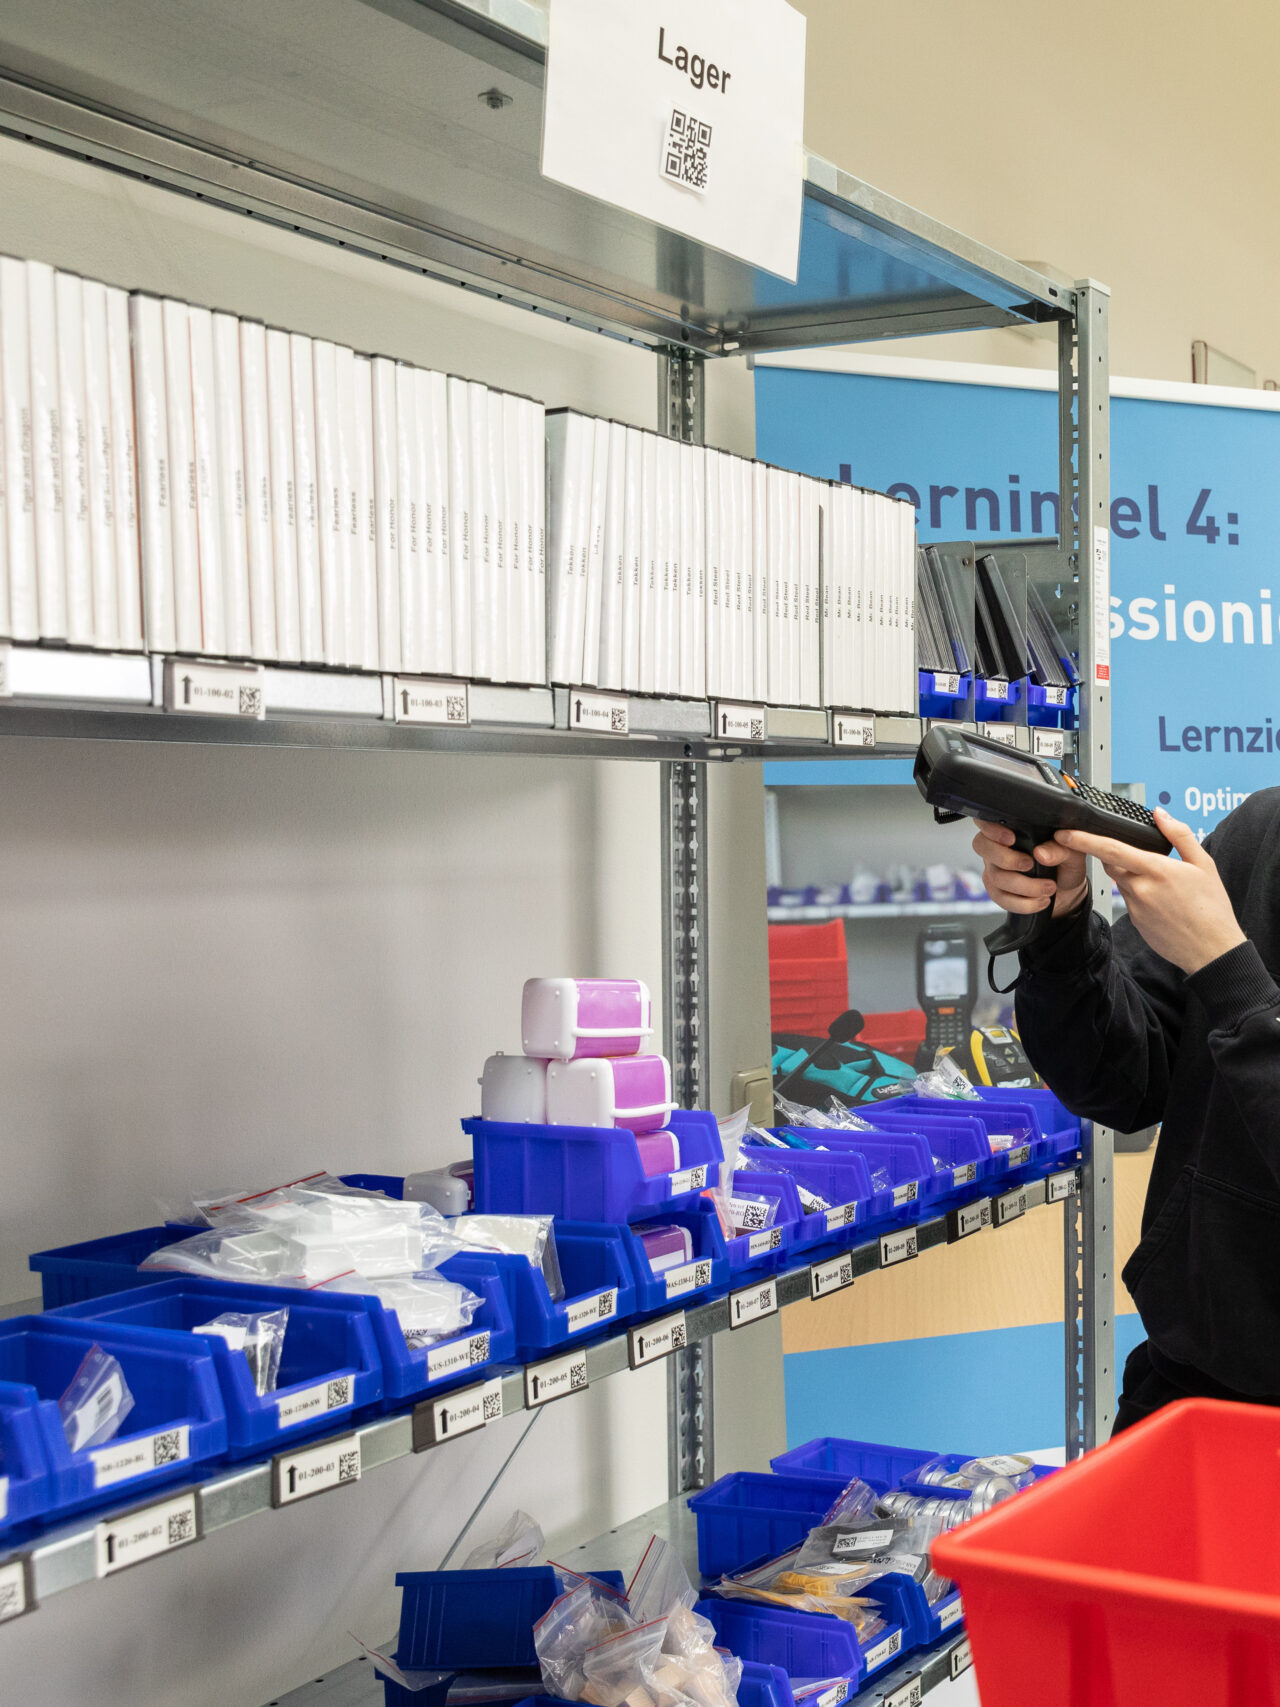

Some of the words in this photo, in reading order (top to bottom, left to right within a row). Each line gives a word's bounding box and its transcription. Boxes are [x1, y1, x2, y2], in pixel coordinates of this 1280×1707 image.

[657, 26, 732, 95] Lager
[159, 458, 167, 508] Fearless
[189, 460, 197, 510] Fearless
[287, 479, 295, 526] Fearless
[333, 487, 341, 532] Fearless
[838, 463, 1167, 542] erninel
[1185, 488, 1240, 546] 4:
[462, 543, 470, 561] For
[672, 562, 680, 592] Tekken
[194, 687, 236, 699] 01-100-02
[582, 708, 610, 719] 01-100-04
[727, 720, 750, 729] 01-100-05
[644, 1333, 670, 1349] 01-200-06
[540, 1372, 568, 1389] 01-200-05
[449, 1404, 480, 1423] 01-200-04
[298, 1462, 335, 1481] 01-200-03
[118, 1524, 163, 1549] 01-200-02
